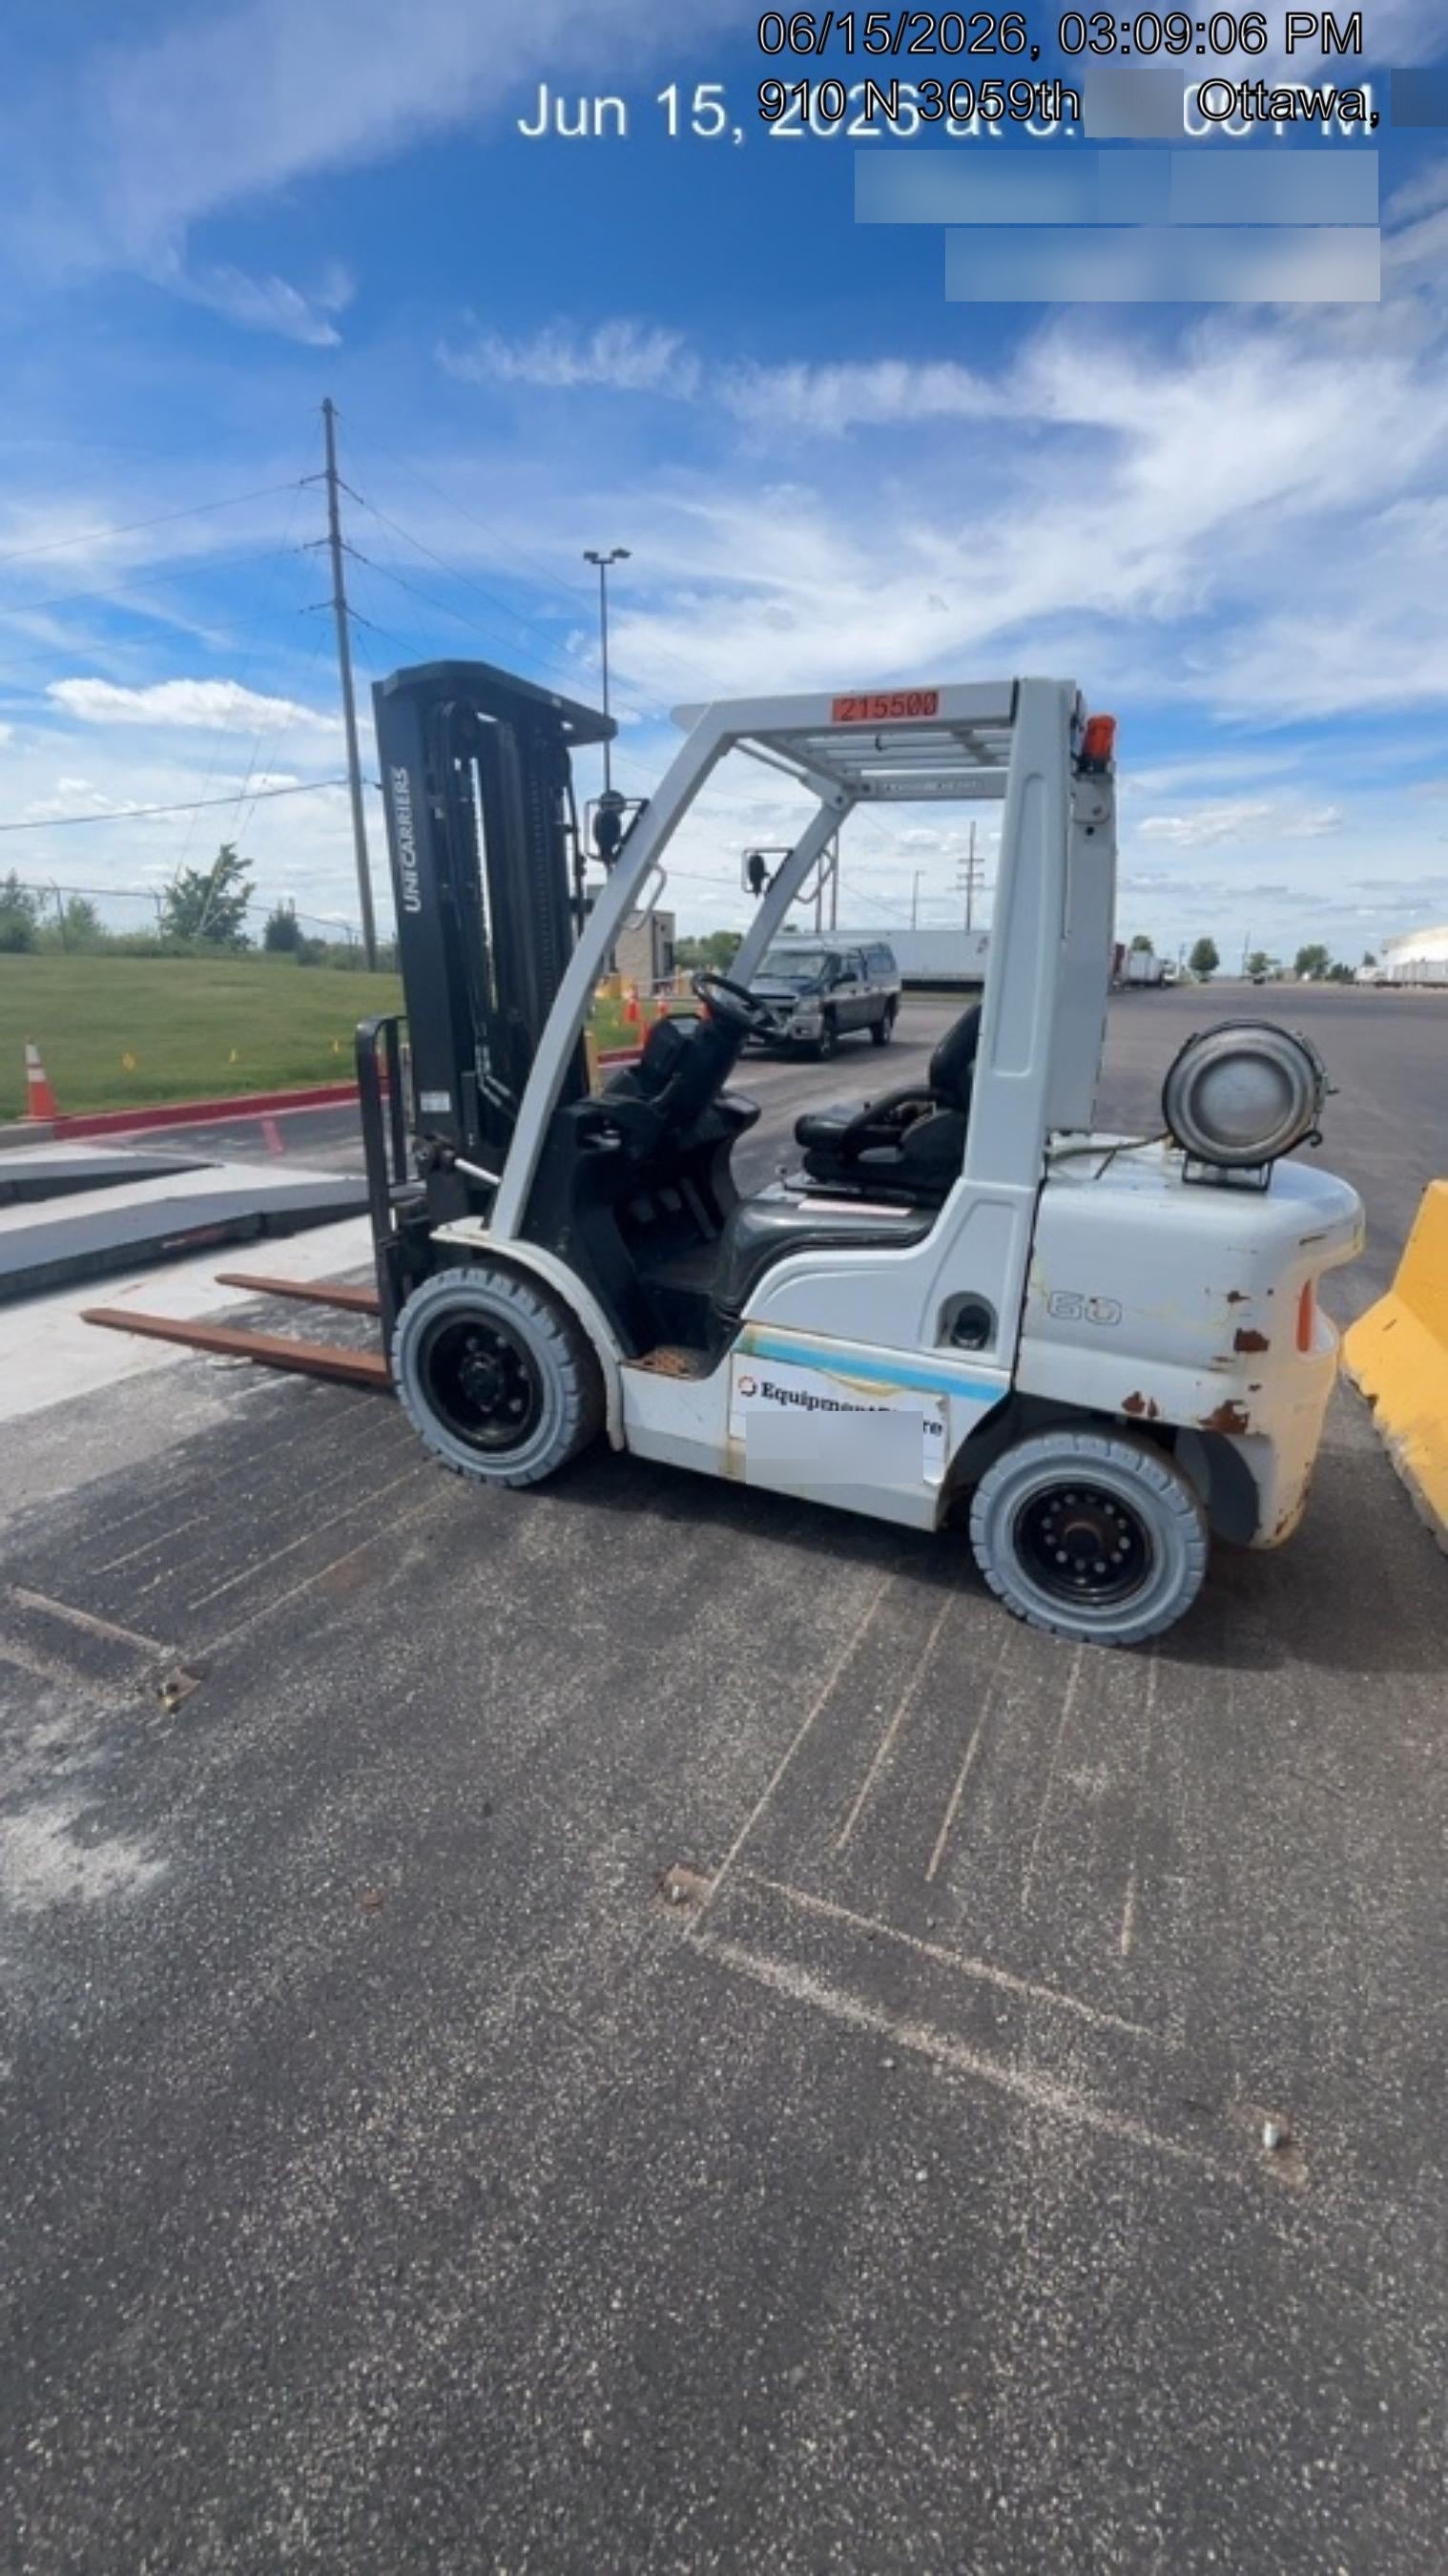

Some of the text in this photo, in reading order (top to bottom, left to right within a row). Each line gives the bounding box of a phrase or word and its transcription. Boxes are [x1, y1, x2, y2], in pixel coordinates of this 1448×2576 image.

[839, 693, 937, 721] 215500
[390, 765, 422, 913] UNICARRIERS
[1046, 1291, 1122, 1325] 60
